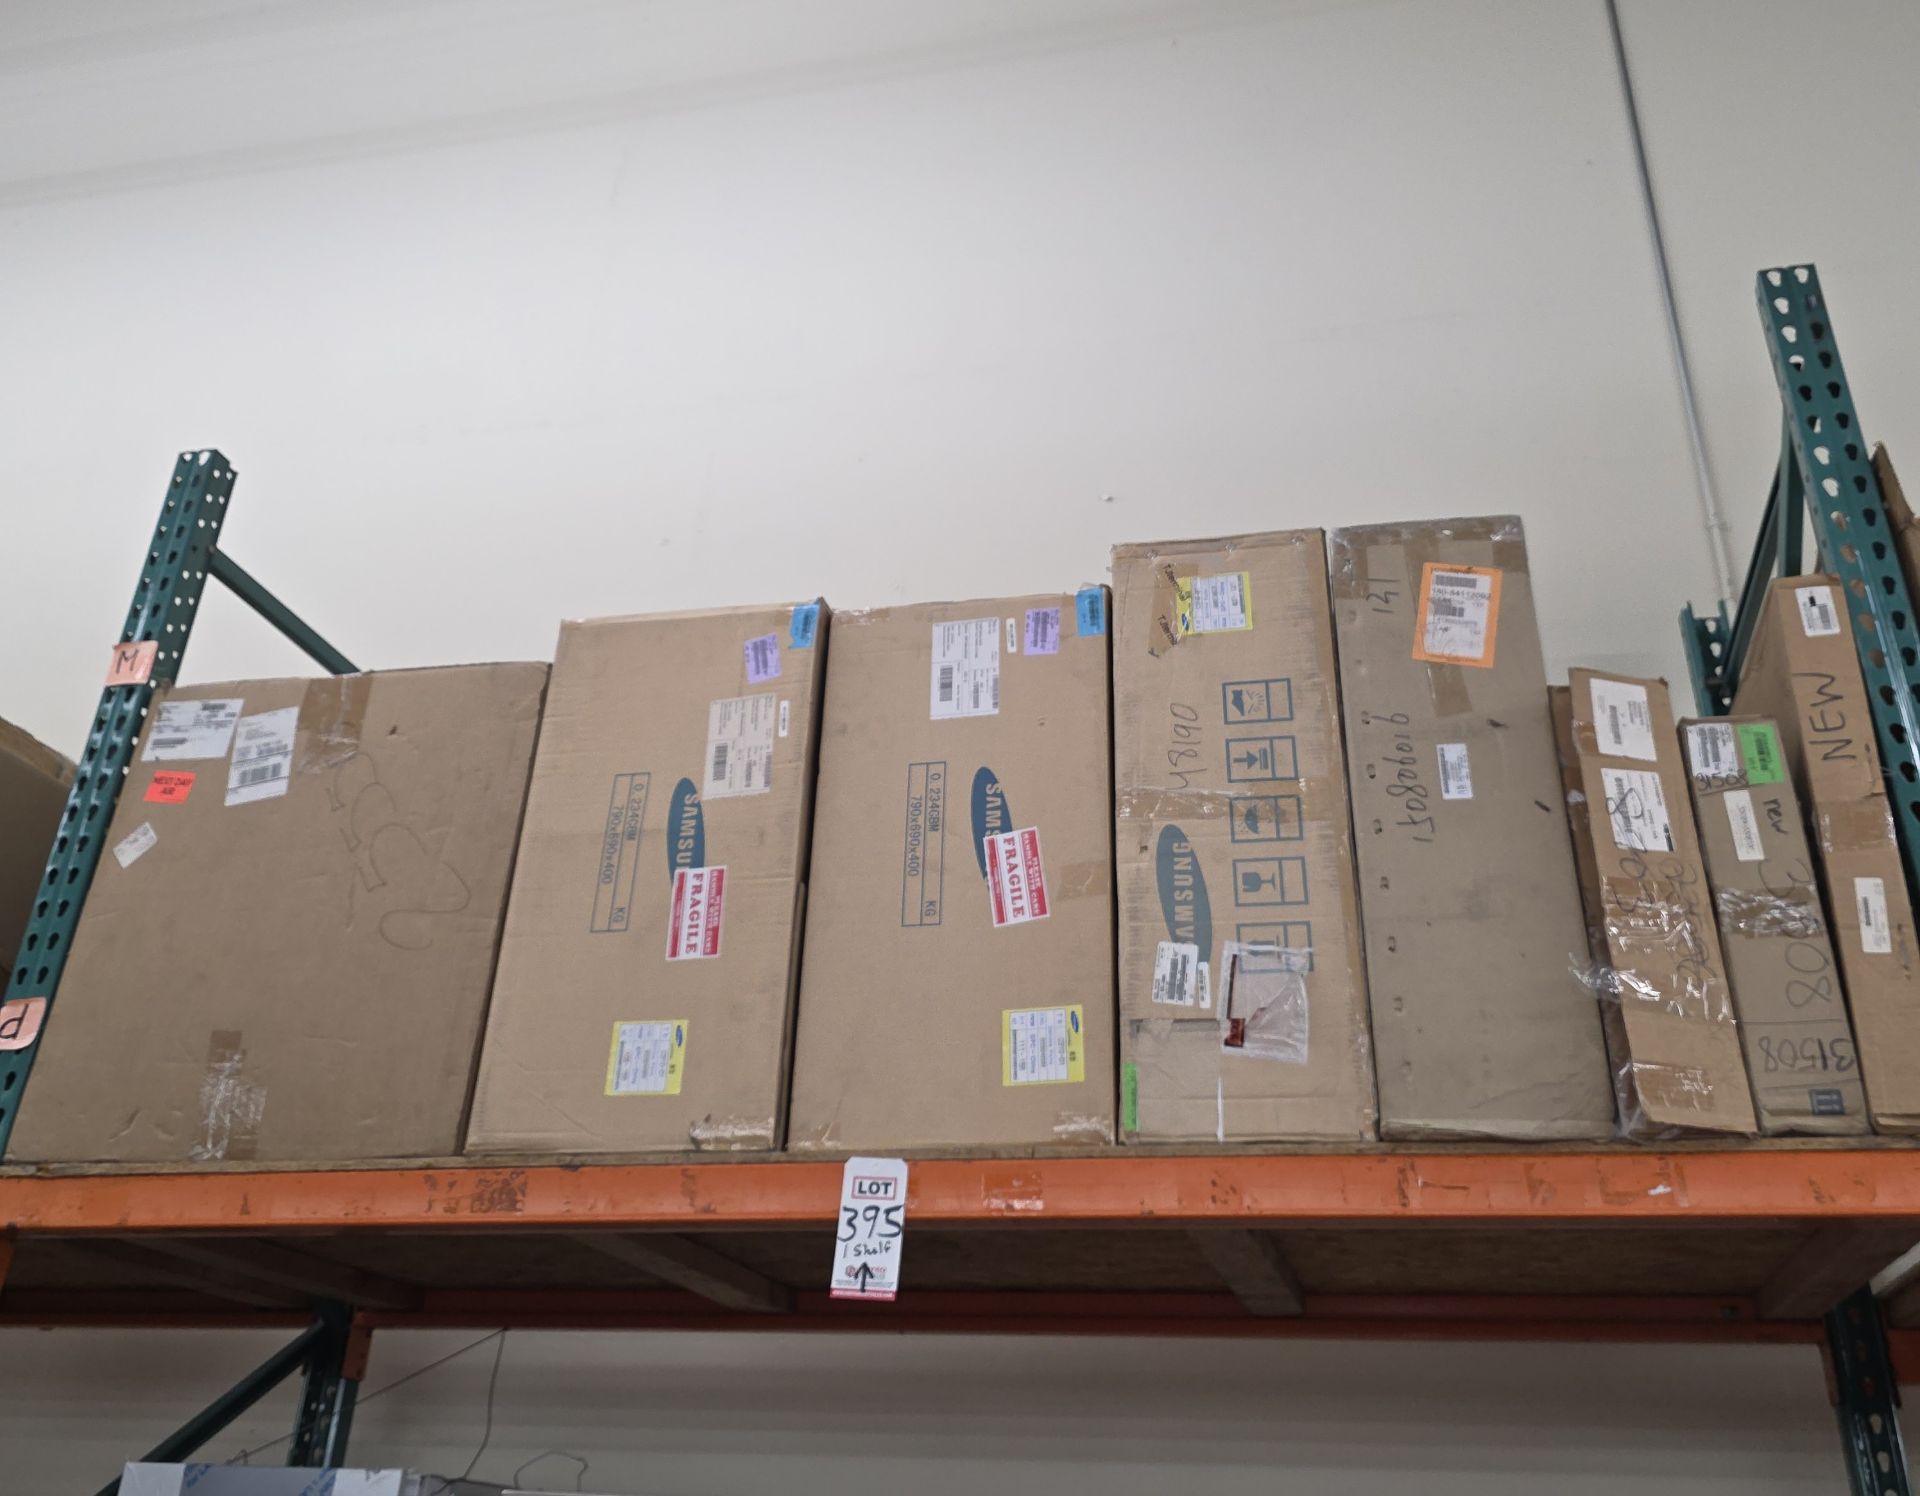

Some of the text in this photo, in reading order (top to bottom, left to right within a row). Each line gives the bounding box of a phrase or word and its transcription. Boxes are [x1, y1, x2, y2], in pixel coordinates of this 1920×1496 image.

[116, 647, 139, 675] M
[1791, 671, 1857, 761] NEW
[675, 793, 700, 866] SAMSU
[1003, 836, 1025, 919] FRAGILE
[1027, 867, 1036, 891] WITH
[1171, 840, 1196, 946] AMSUNG
[611, 906, 626, 923] KG
[684, 872, 705, 955] FRAGILE
[923, 899, 937, 917] KG
[1030, 892, 1040, 915] CARE
[1757, 1035, 1856, 1072] 31508
[857, 1181, 892, 1195] LOT
[837, 1204, 904, 1243] 395
